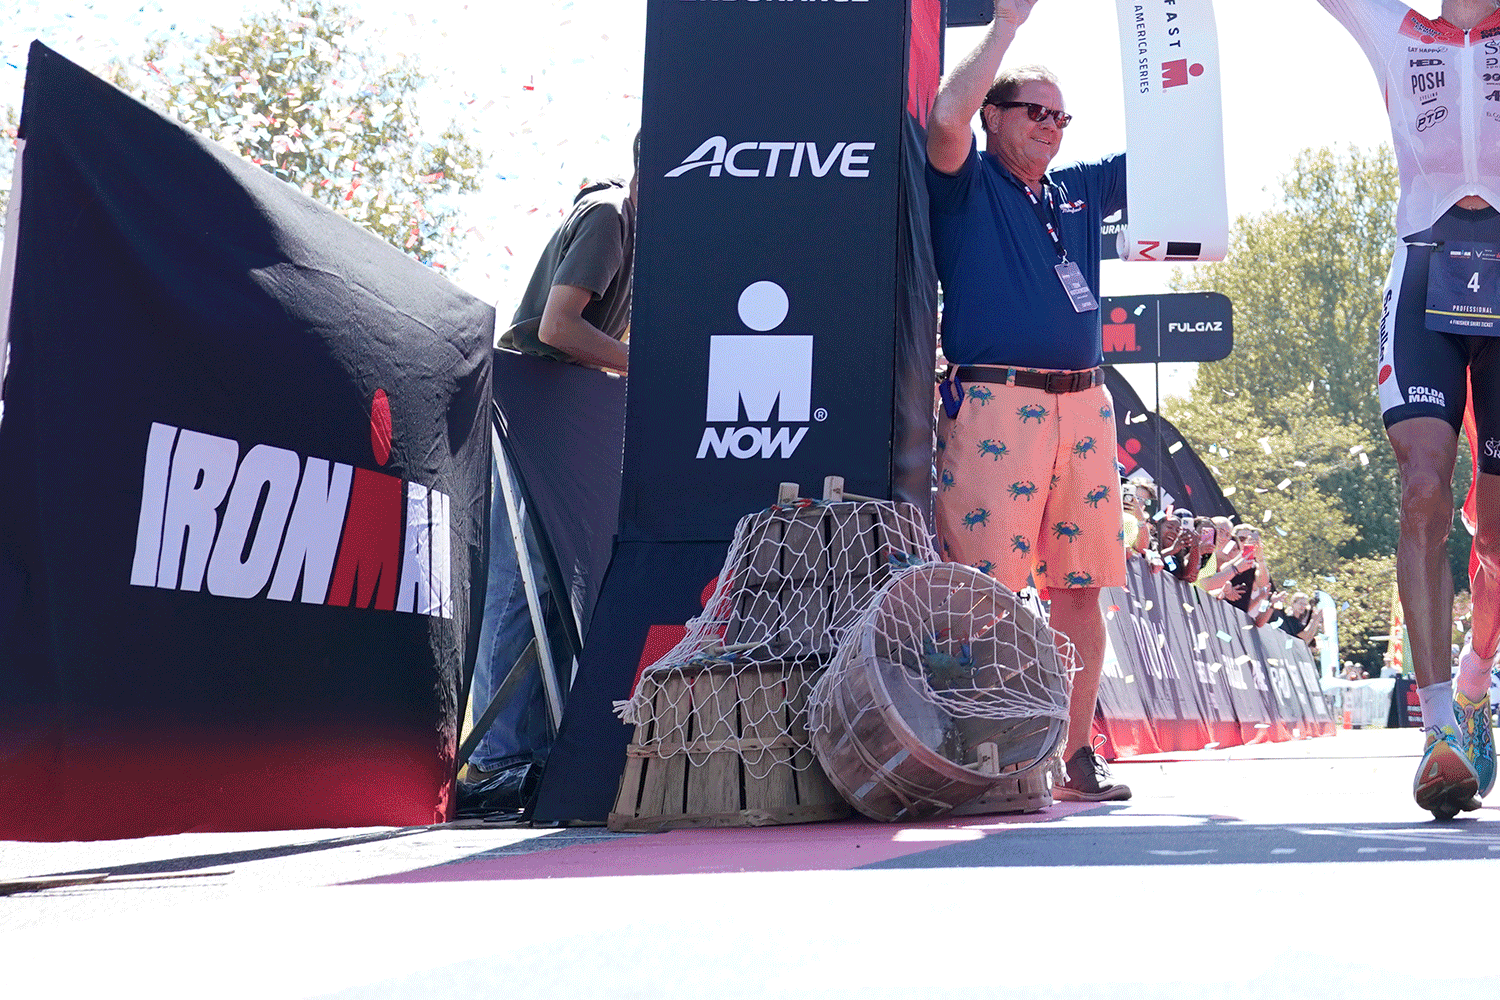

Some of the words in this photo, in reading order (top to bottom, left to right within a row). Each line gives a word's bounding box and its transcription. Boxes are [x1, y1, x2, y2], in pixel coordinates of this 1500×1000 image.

[1134, 5, 1148, 55] AMERICA
[1139, 57, 1150, 94] SERIES
[1411, 71, 1445, 94] POSH
[664, 135, 875, 177] ACTIVE
[1467, 272, 1480, 293] 4
[1452, 305, 1492, 314] PROFESSIONAL
[1168, 321, 1223, 333] FULGAZ
[1408, 386, 1445, 400] COLDA
[1409, 395, 1446, 408] MARIS
[696, 427, 809, 459] NOW
